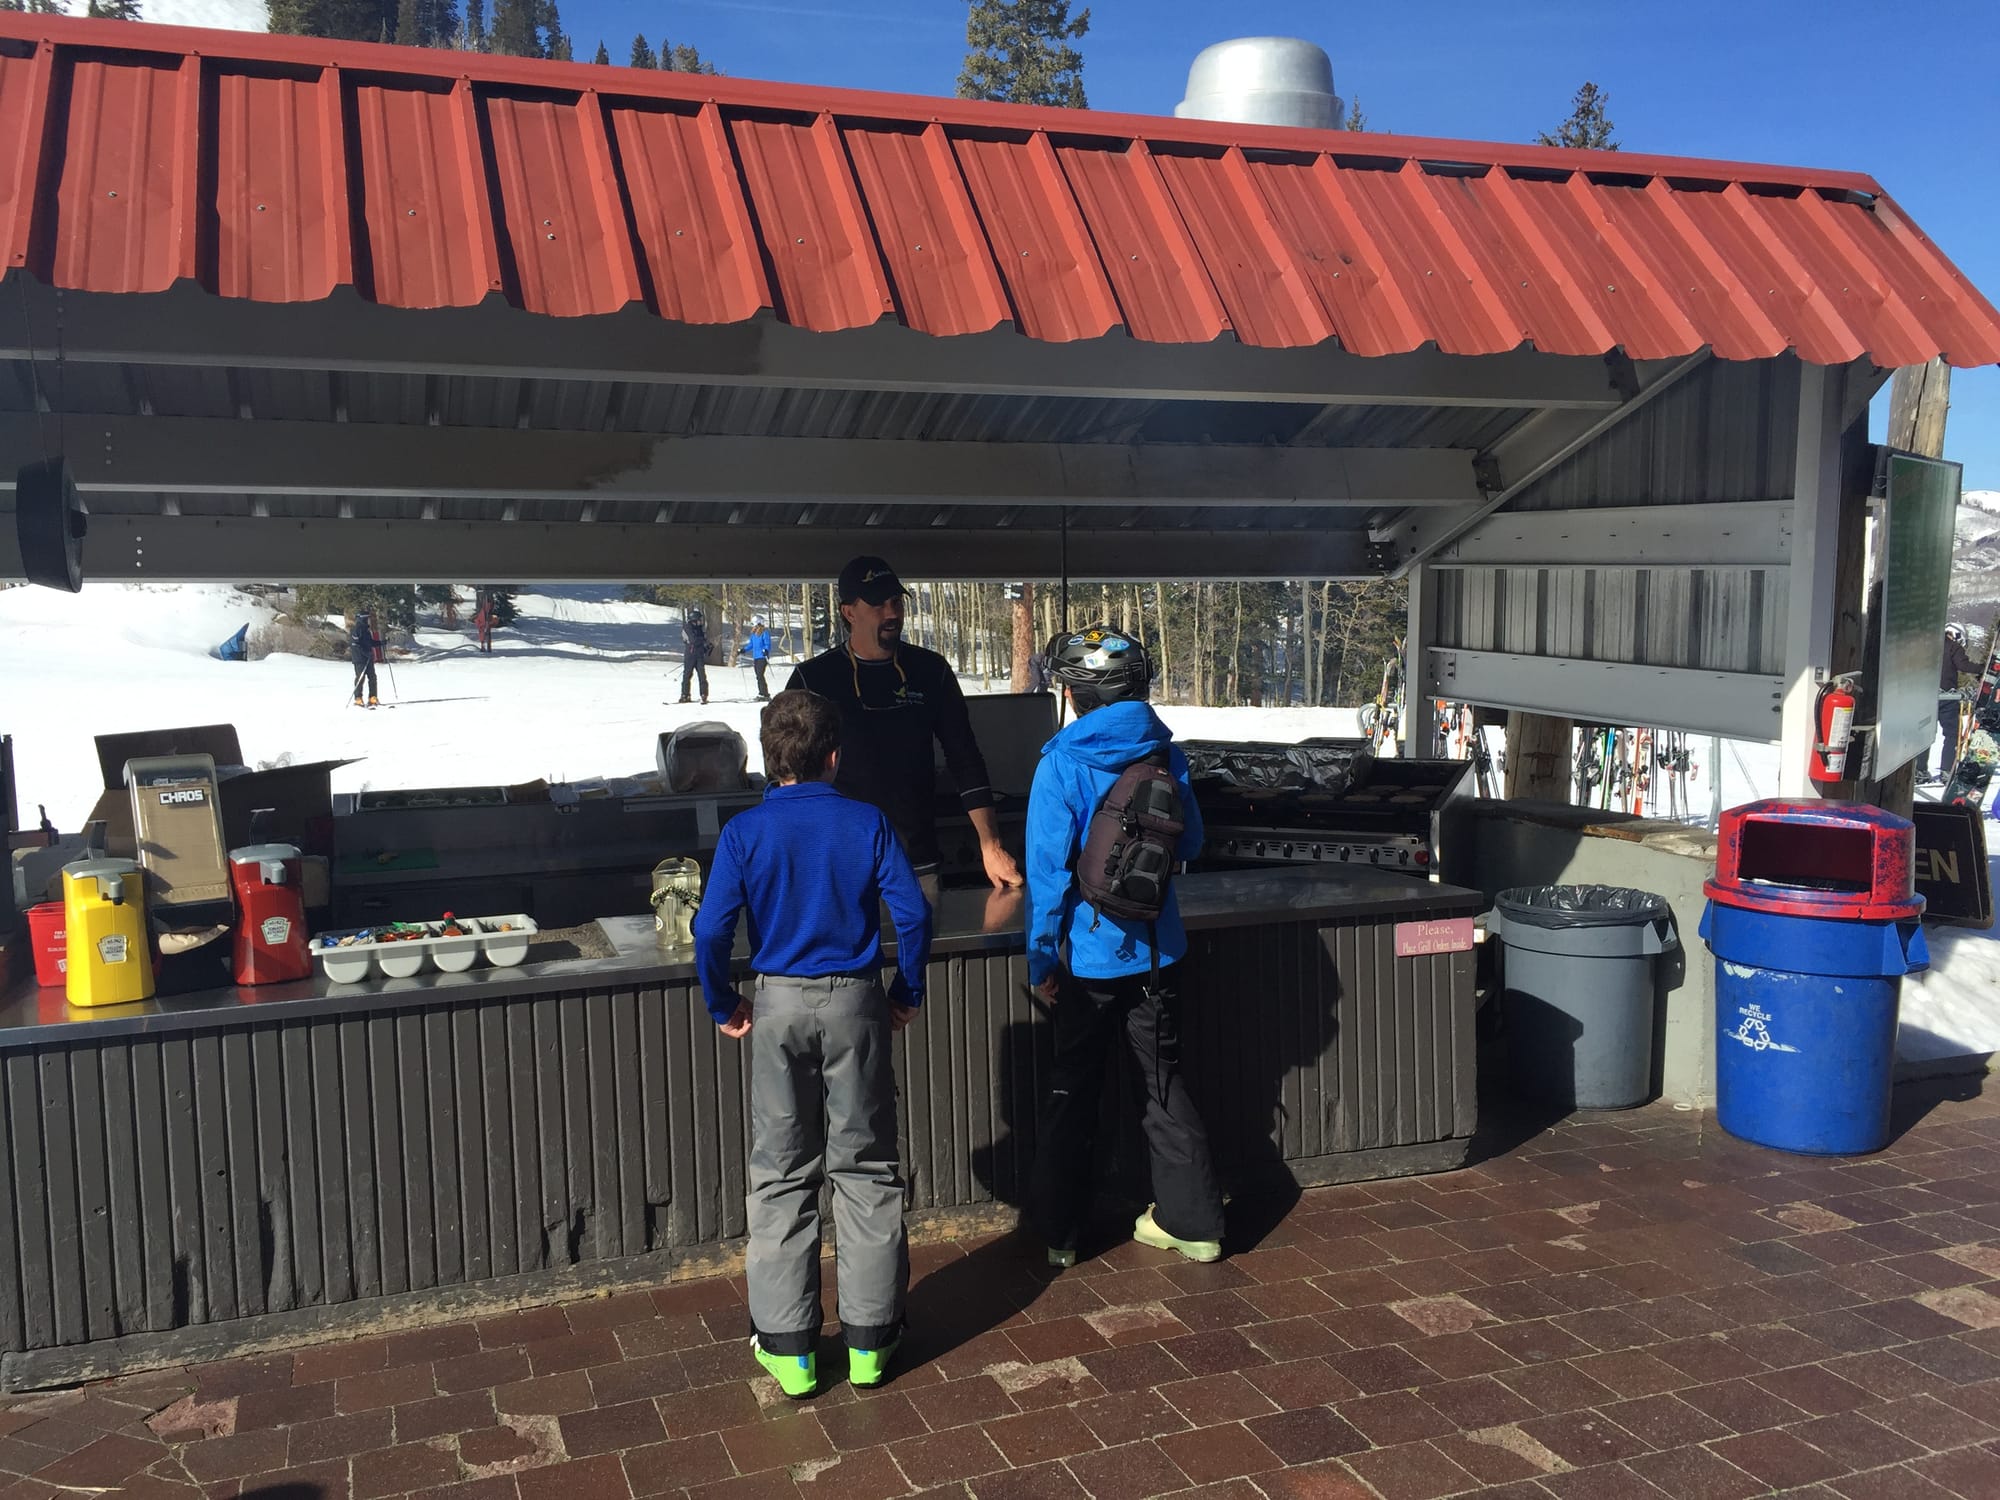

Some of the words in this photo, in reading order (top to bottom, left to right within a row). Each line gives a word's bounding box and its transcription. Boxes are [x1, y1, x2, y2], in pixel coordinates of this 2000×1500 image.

[160, 789, 204, 804] CHAOS
[1739, 1006, 1772, 1021] RECYCLE
[1749, 1003, 1760, 1012] WE
